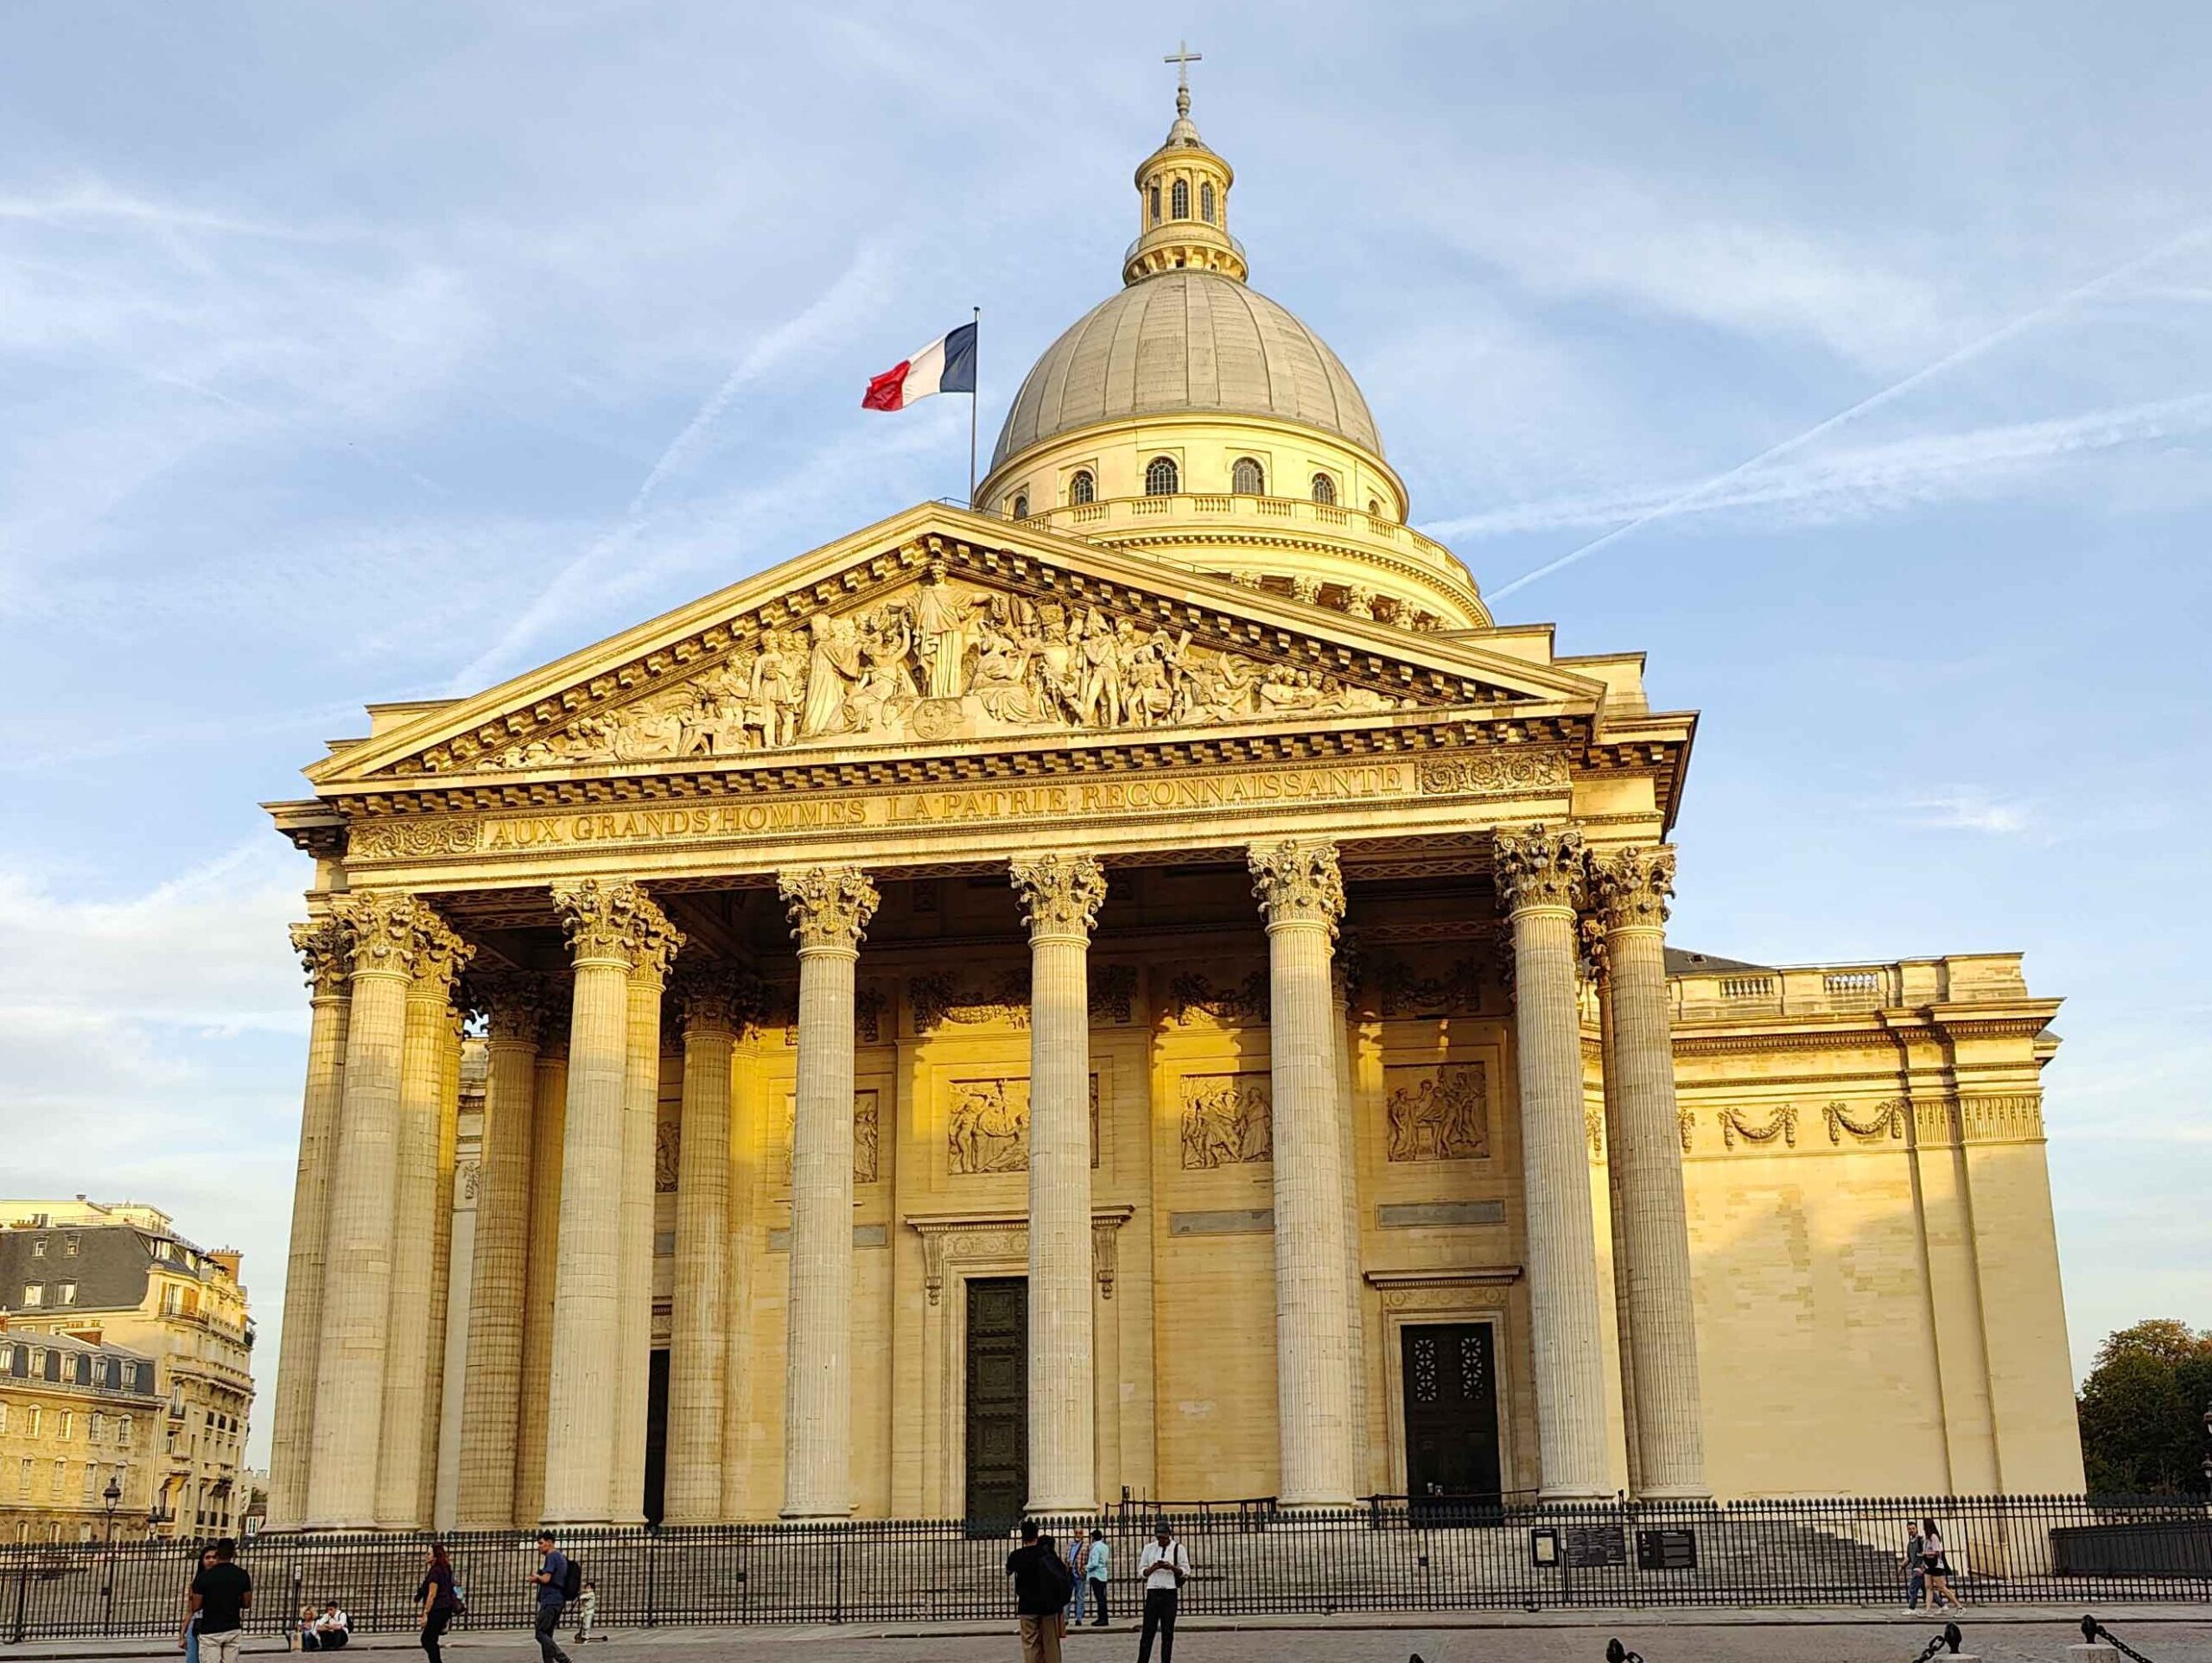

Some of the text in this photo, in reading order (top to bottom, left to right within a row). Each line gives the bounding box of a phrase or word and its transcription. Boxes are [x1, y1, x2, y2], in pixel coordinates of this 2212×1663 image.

[491, 766, 1402, 847] AUX GRANDS HOMMES LA PATRIE RECONNAISSANTE
